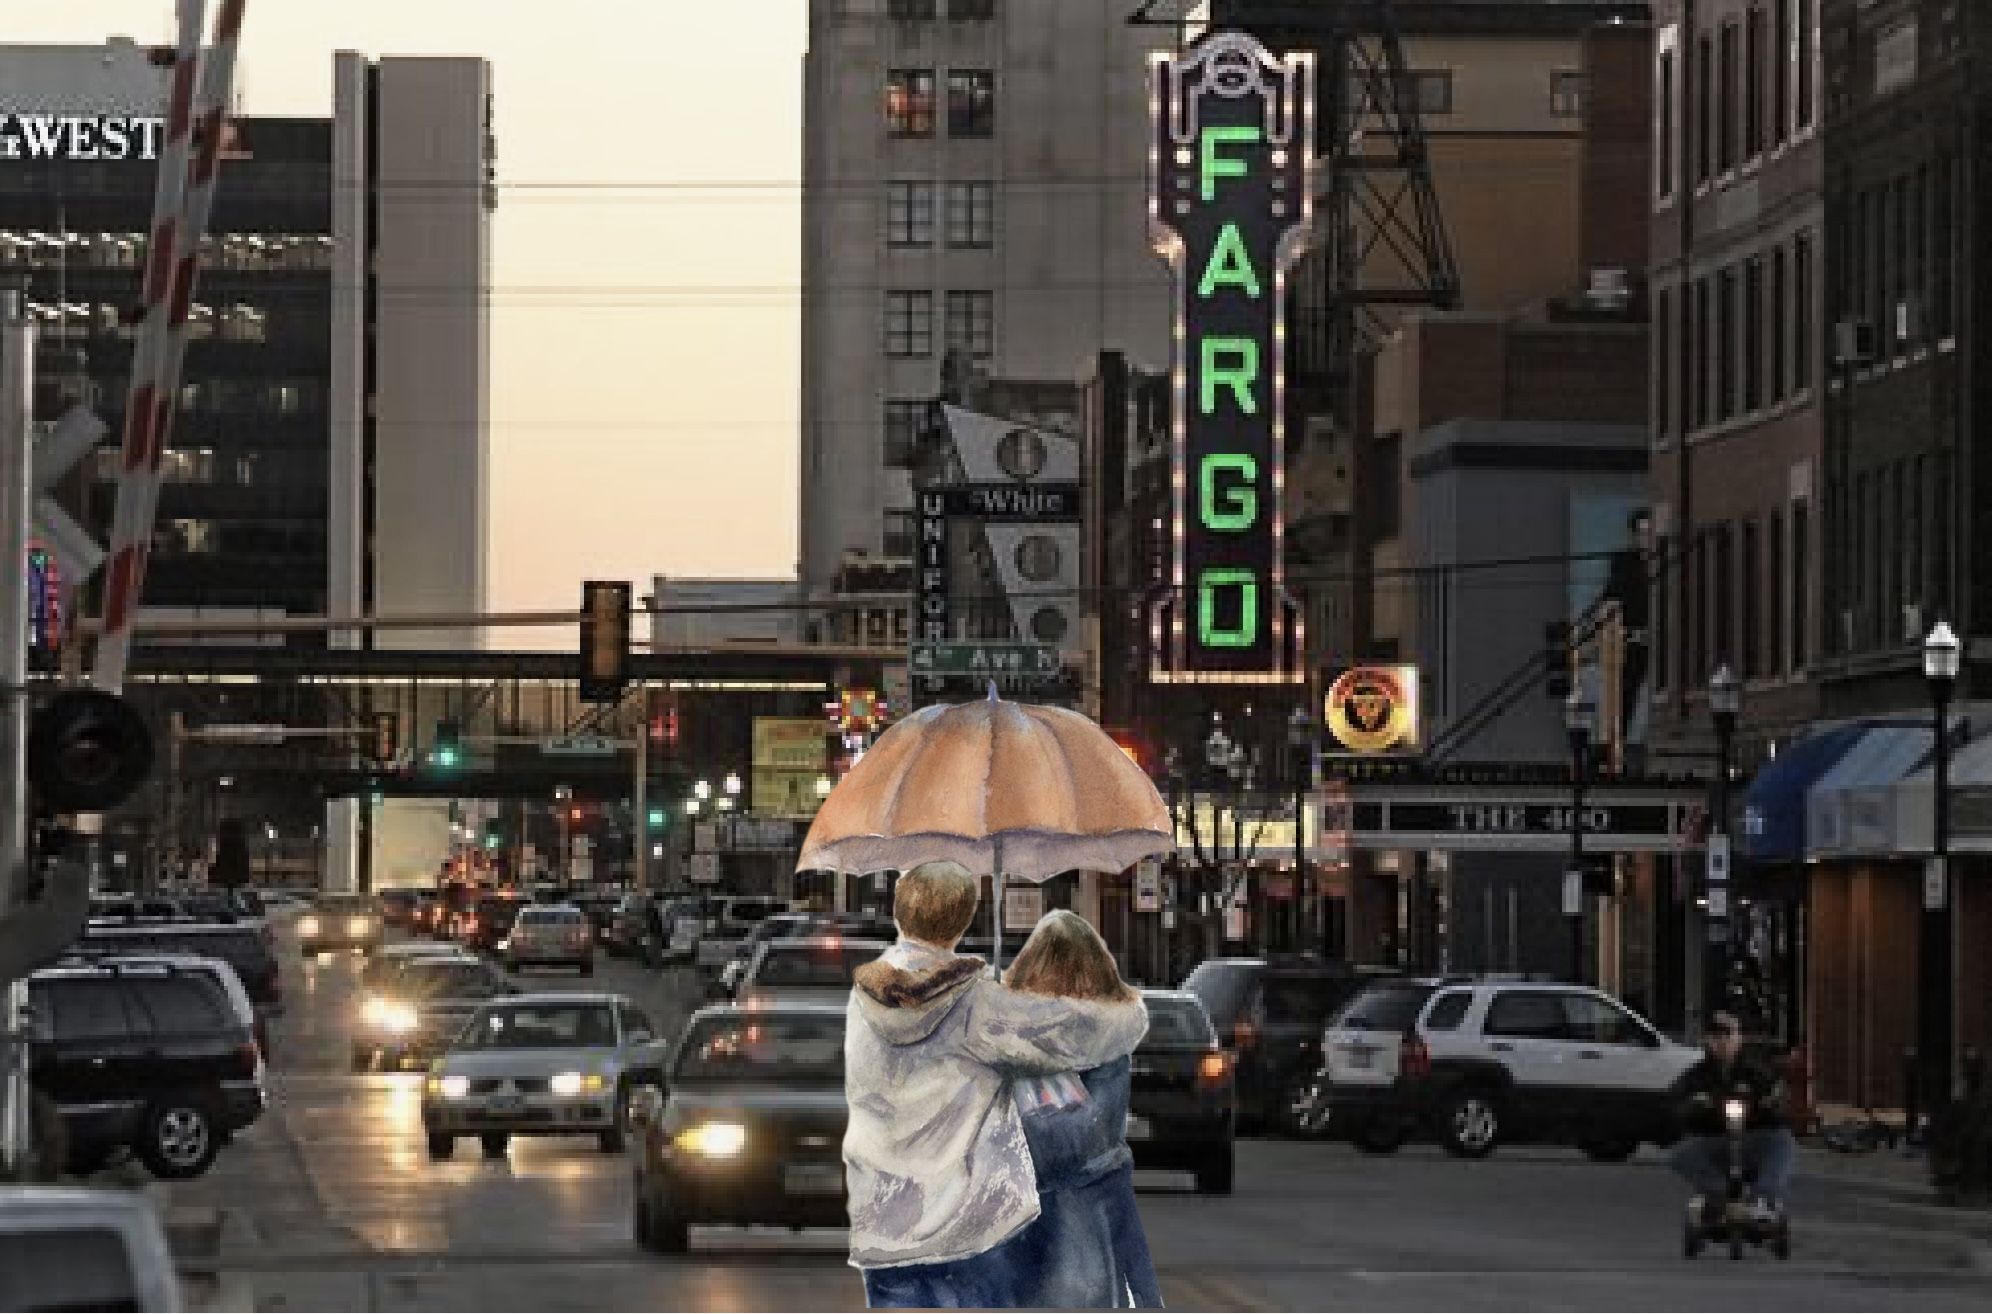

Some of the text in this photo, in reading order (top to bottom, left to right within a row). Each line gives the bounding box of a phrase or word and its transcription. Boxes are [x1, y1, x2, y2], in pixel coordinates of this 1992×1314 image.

[18, 115, 165, 159] WEST
[1199, 126, 1261, 648] FARGO
[970, 649, 1023, 668] Ave
[1447, 806, 1526, 831] THE
